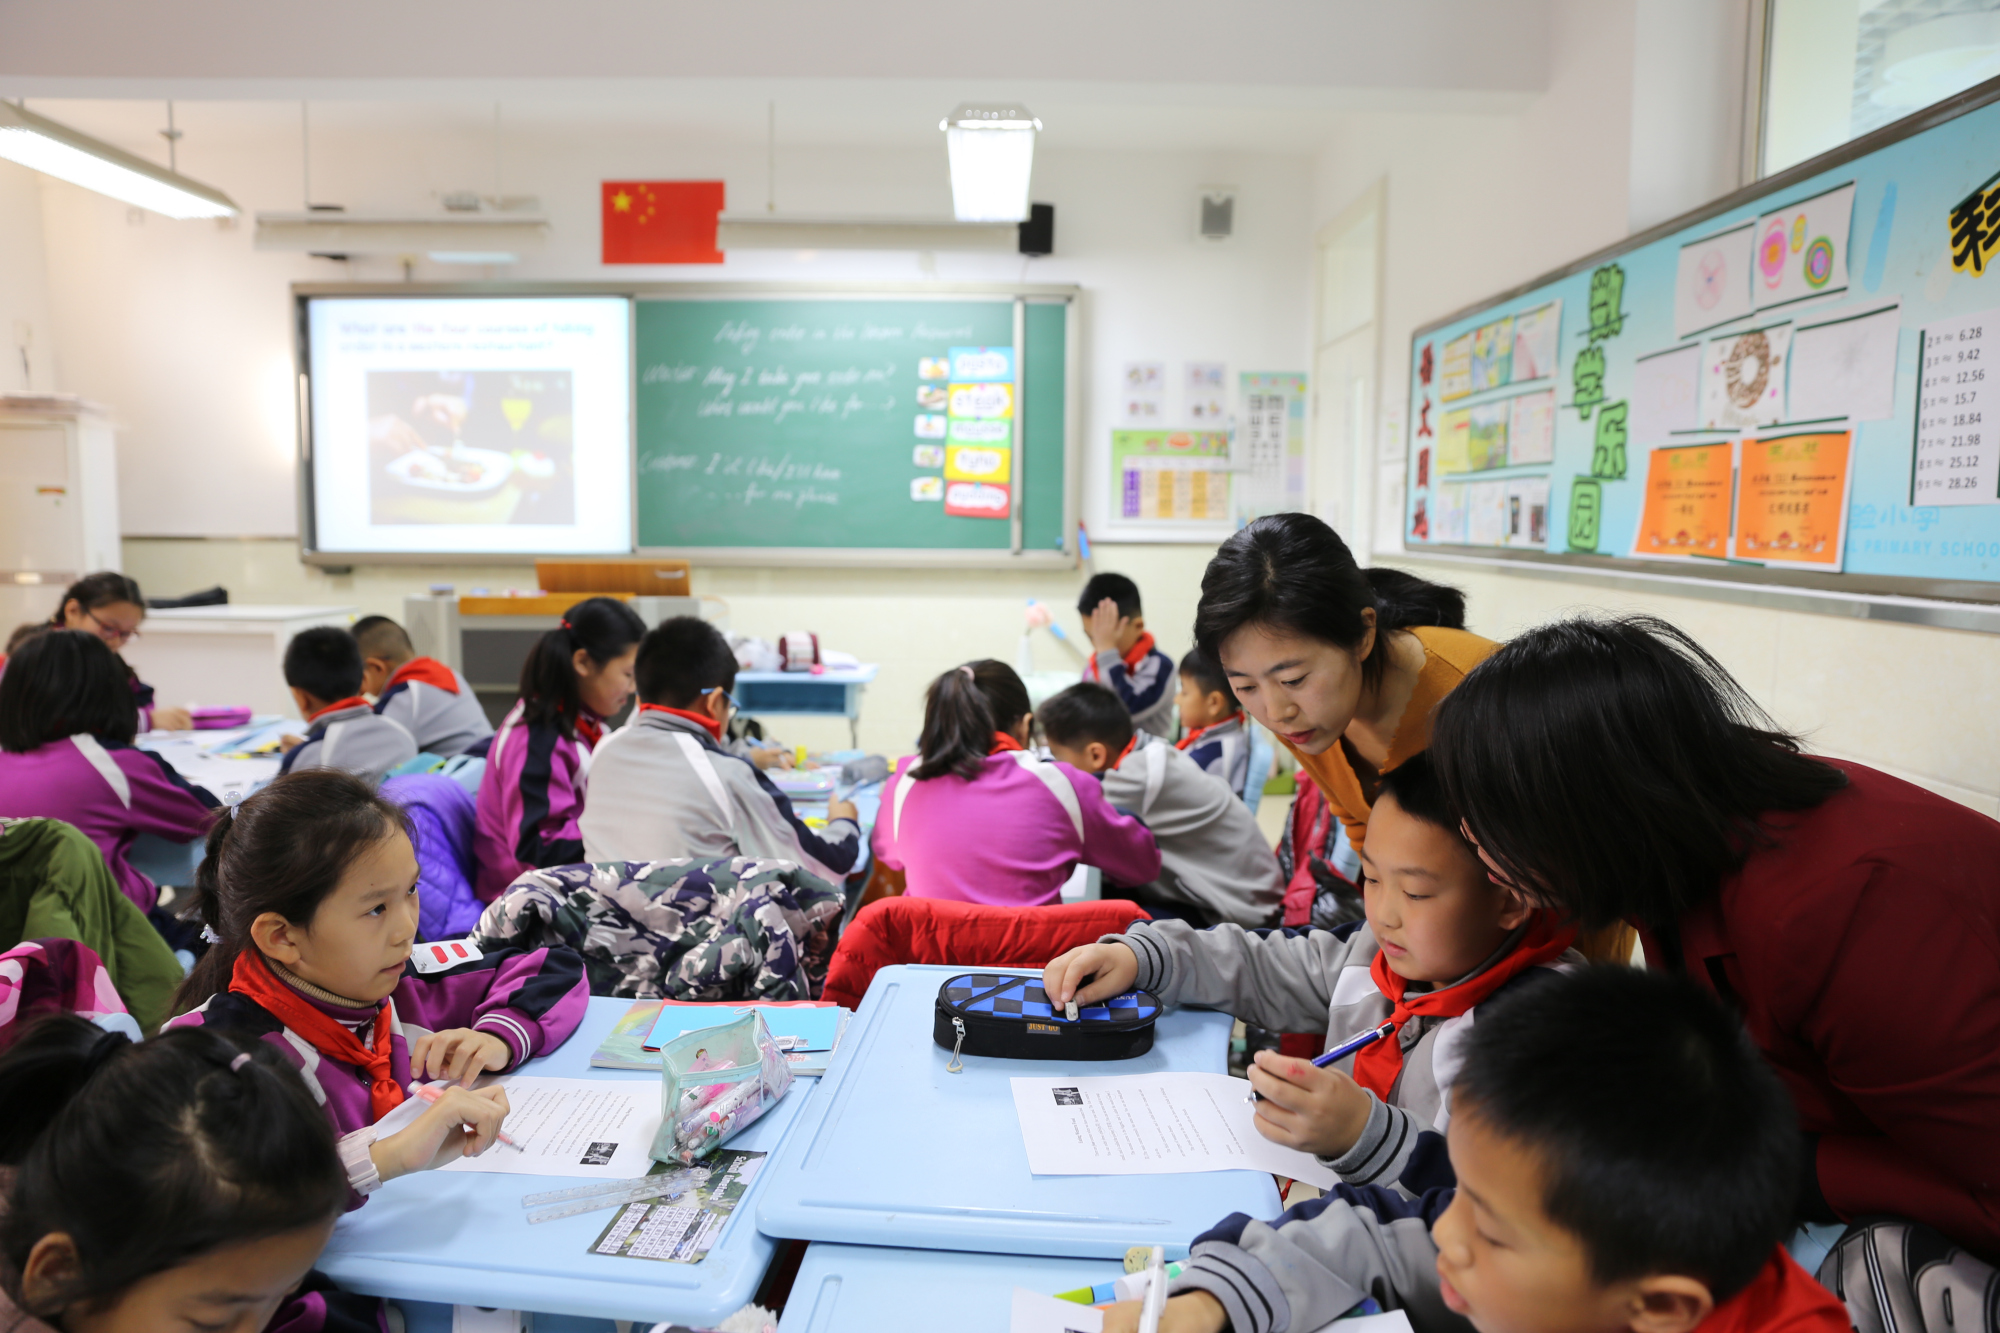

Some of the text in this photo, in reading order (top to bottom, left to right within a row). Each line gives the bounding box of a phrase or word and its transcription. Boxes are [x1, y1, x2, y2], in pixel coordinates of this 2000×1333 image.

[1959, 327, 1982, 341] 6.28
[1957, 349, 1980, 363] 9.42
[1956, 369, 1985, 384] 12.56
[1955, 391, 1976, 405] 15.7
[1953, 412, 1981, 426] 18.84
[1951, 433, 1981, 447] 21.98
[1950, 455, 1978, 468] 25.12
[1948, 476, 1977, 489] 28.26
[1864, 539, 1932, 554] PRIMARY
[1028, 1022, 1046, 1031] JUST
